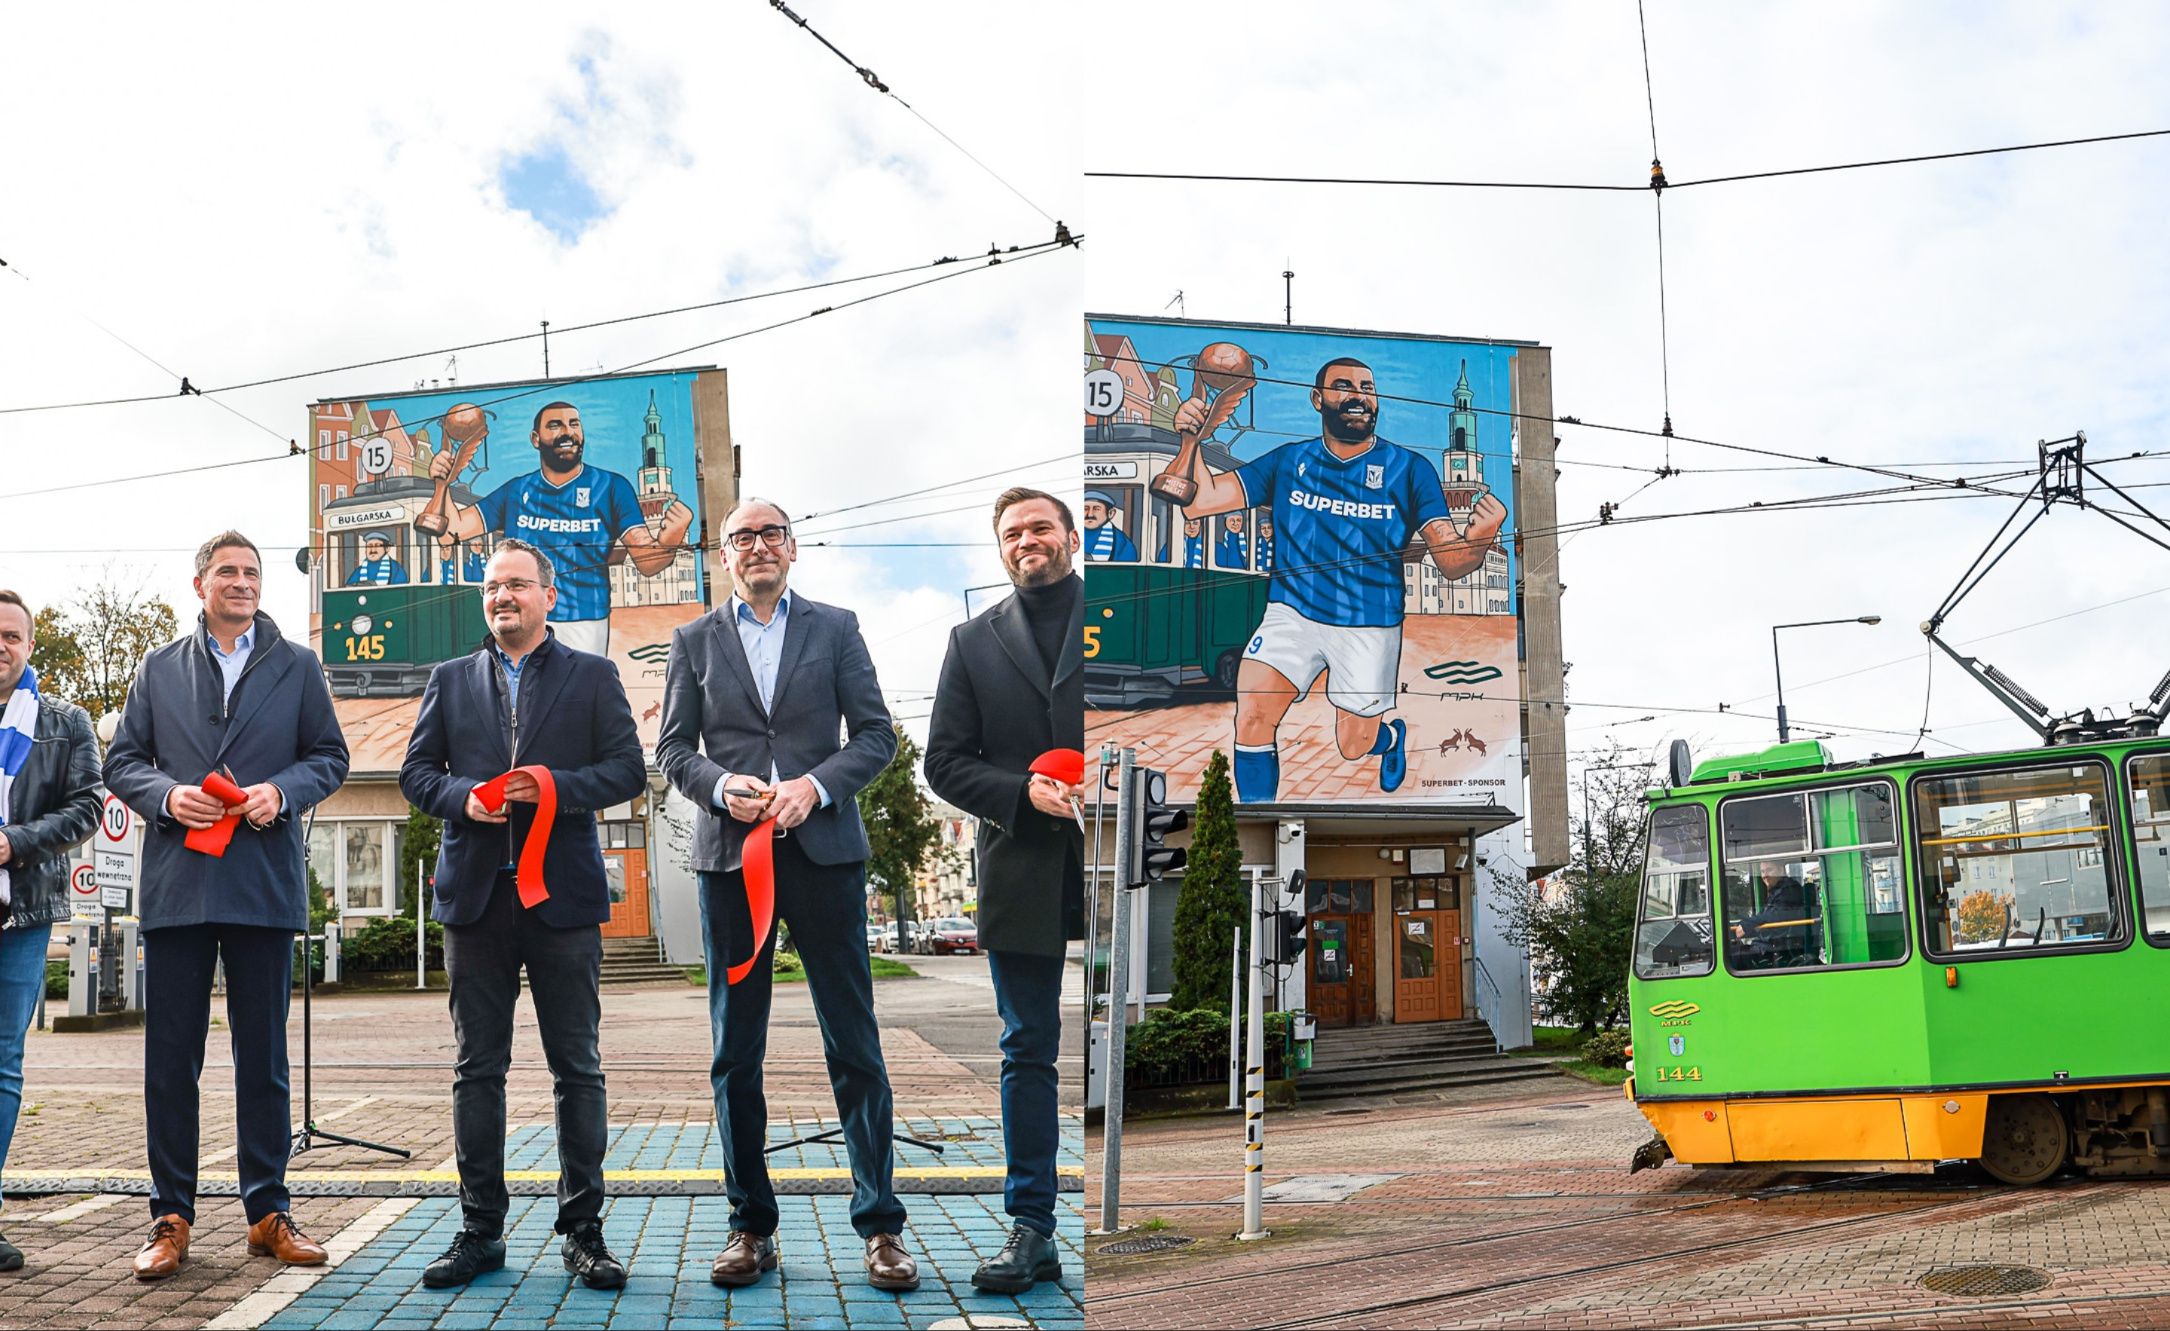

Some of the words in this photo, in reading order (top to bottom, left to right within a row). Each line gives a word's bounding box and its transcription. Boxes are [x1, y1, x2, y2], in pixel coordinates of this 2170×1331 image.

[1089, 382, 1112, 407] 15
[368, 446, 385, 467] 15
[1289, 490, 1396, 519] SUPERBET
[338, 510, 392, 525] BUŁGARSKA
[516, 515, 601, 533] SUPERBET
[345, 634, 385, 661] 145
[1248, 635, 1263, 655] 9
[1440, 692, 1484, 701] MPK
[108, 807, 124, 830] 10
[105, 856, 124, 869] Droga
[79, 872, 95, 886] 10
[1657, 1066, 1702, 1081] 144
